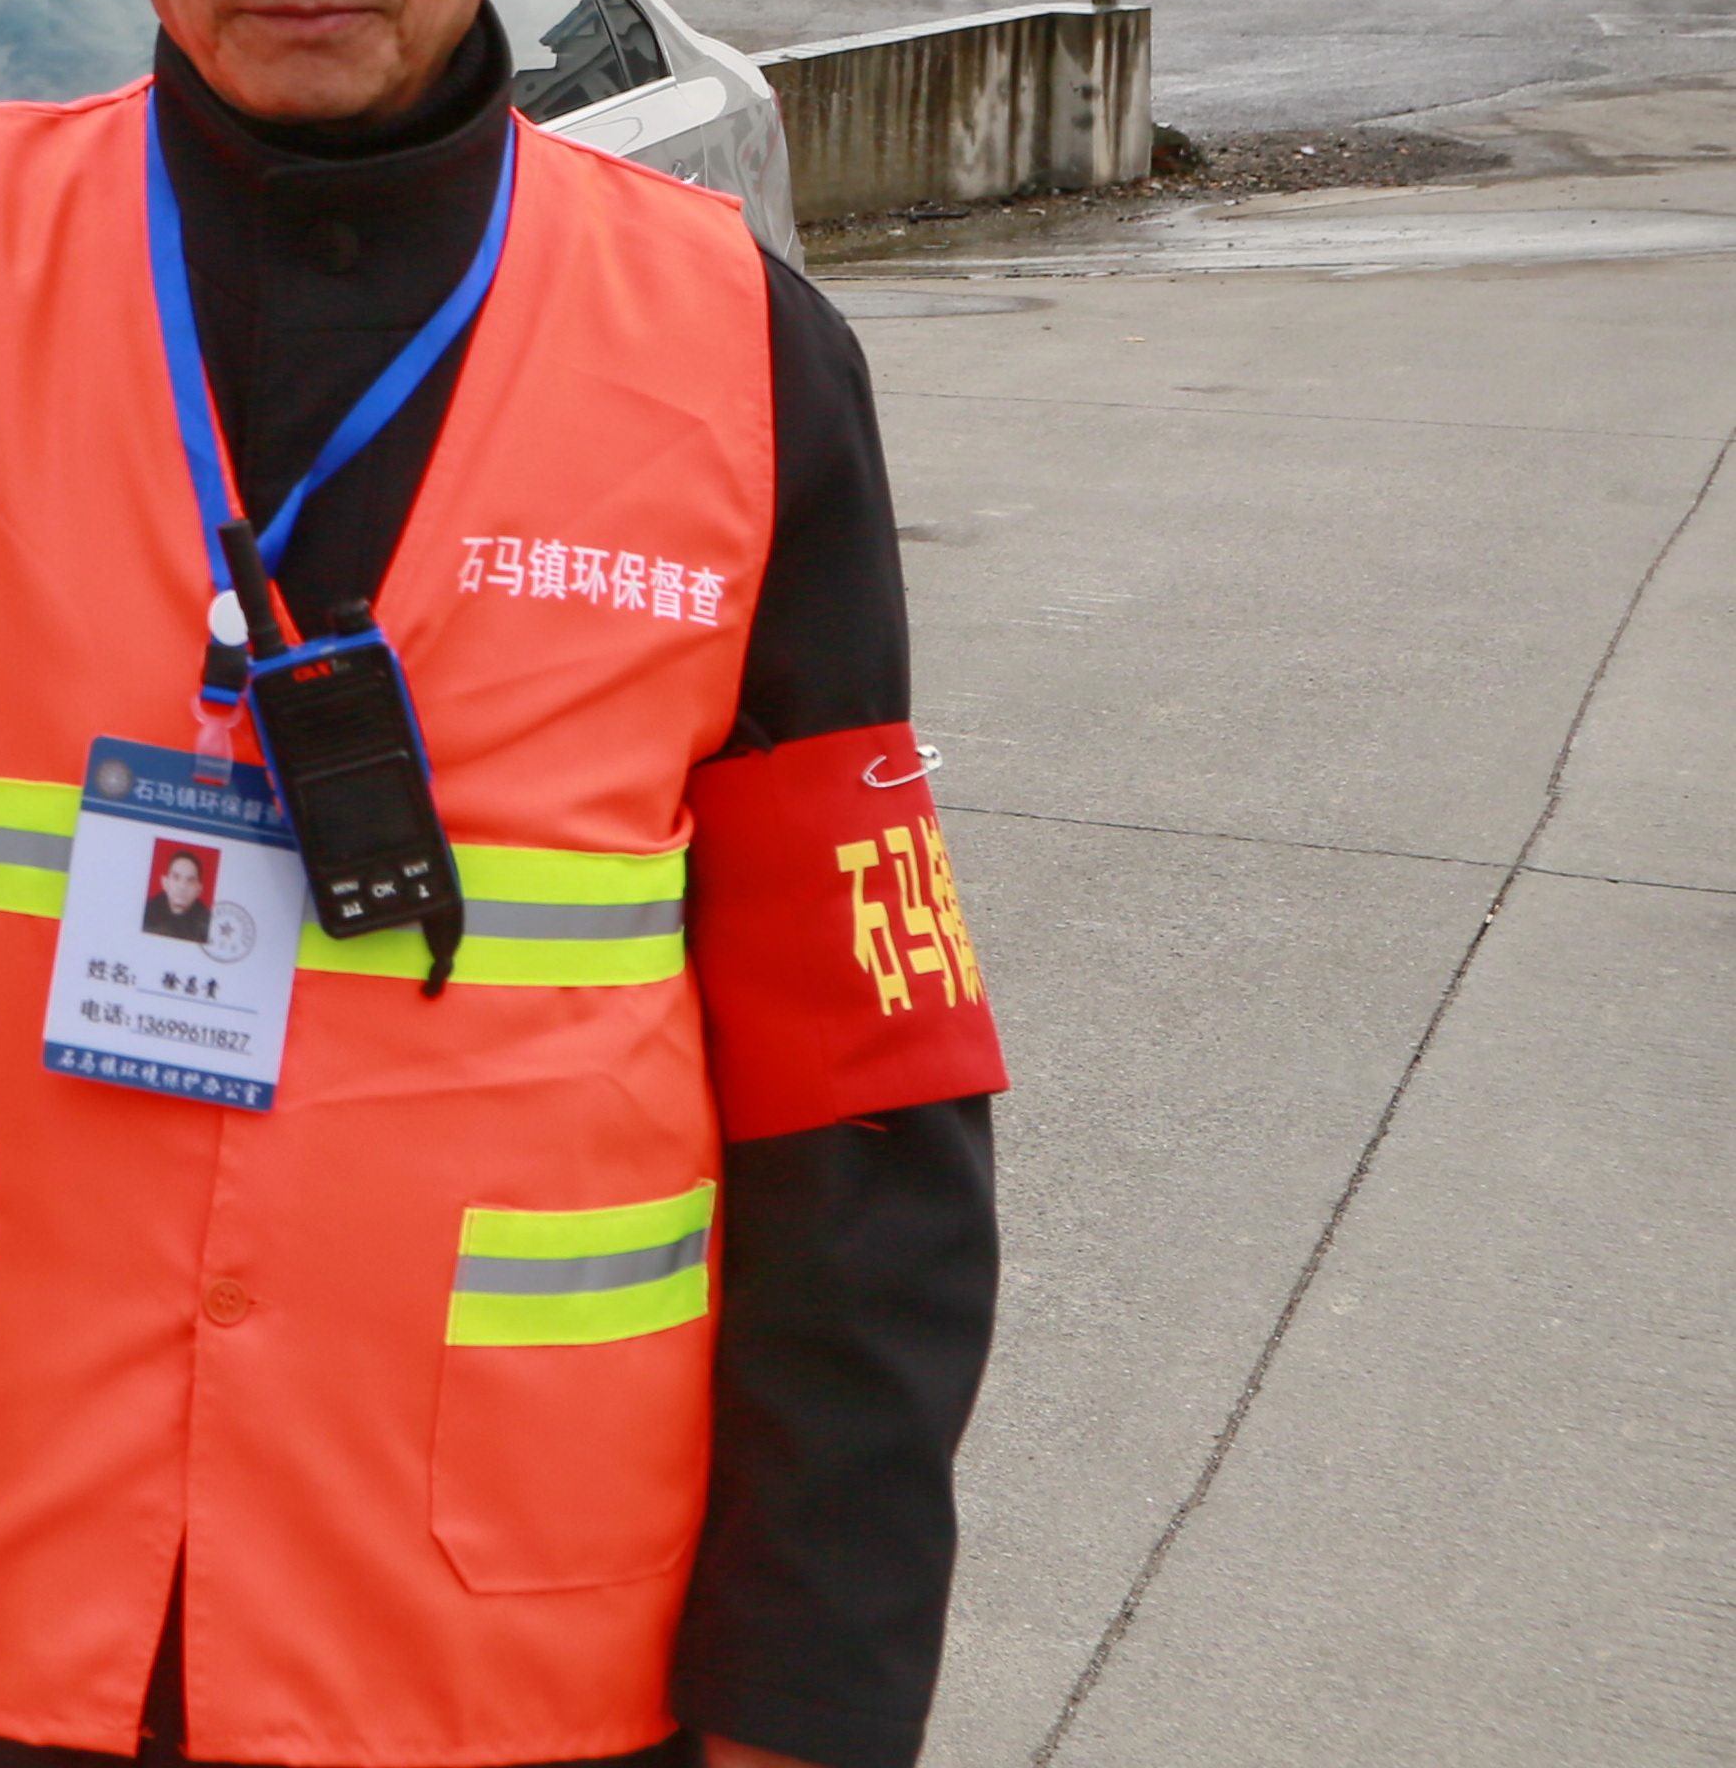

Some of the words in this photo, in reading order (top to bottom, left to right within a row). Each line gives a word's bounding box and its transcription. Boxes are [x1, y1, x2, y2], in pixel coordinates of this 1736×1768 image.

[458, 535, 725, 627] 石马镇环保督查
[372, 881, 397, 899] OK
[57, 1048, 262, 1106] 石马镇环境保护办公室
